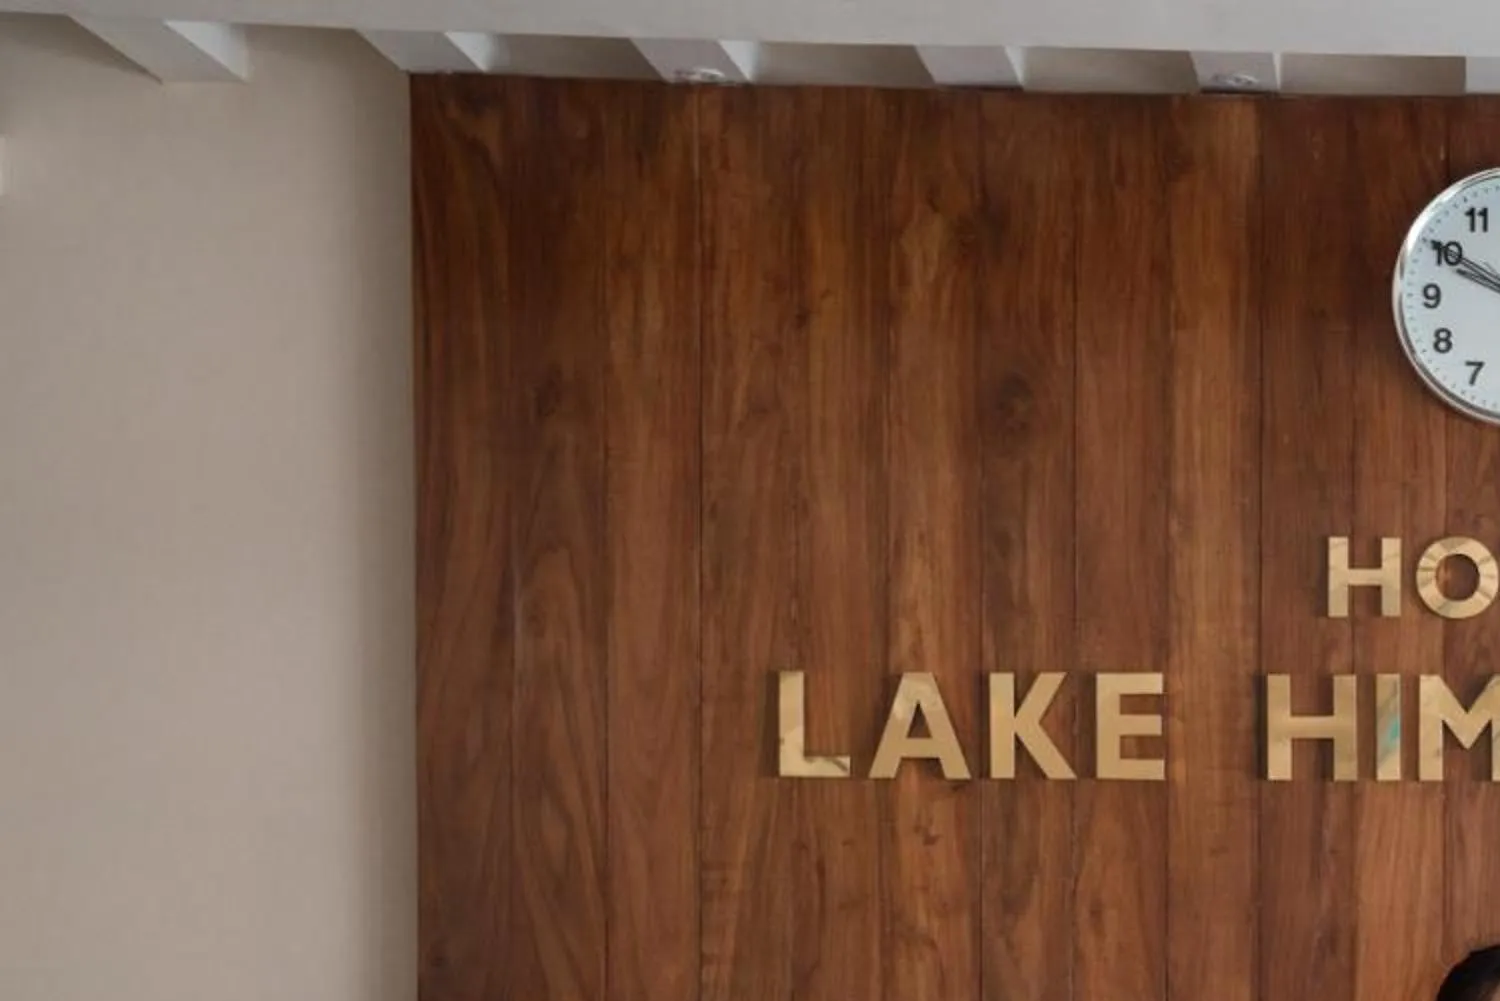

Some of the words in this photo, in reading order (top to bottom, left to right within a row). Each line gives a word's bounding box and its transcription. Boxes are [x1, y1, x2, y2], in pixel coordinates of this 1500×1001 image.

[1465, 207, 1489, 232] 11
[1431, 240, 1463, 266] 10
[1422, 283, 1442, 309] 9
[1433, 327, 1453, 354] 8
[1465, 361, 1485, 386] 7
[776, 670, 1166, 781] LAKE
